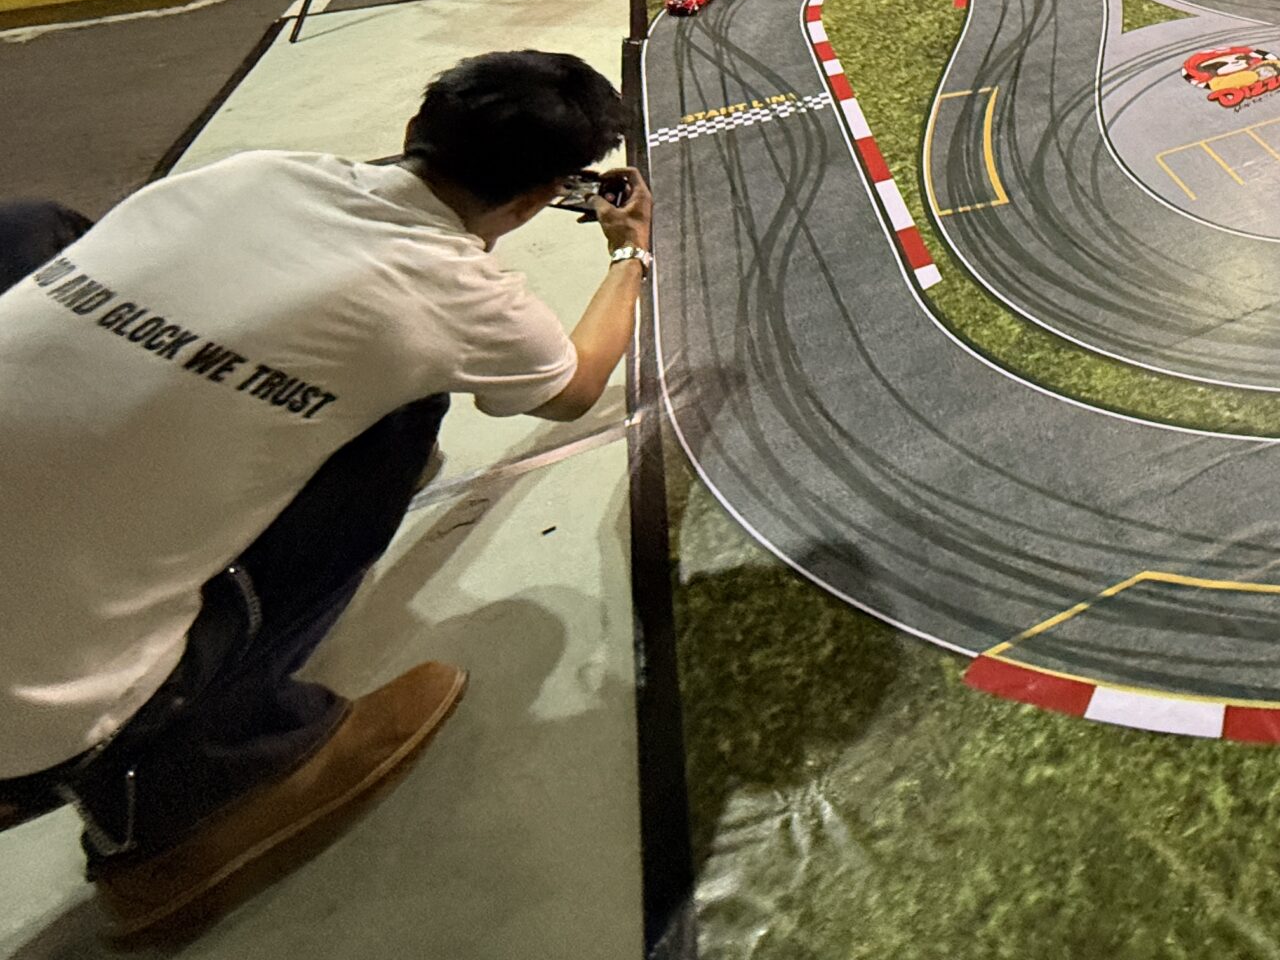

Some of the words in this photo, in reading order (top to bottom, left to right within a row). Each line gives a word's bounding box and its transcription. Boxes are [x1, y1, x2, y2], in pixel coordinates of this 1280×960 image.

[47, 274, 117, 315] AND
[97, 302, 200, 360] GLOCK
[182, 342, 249, 383] WE
[235, 364, 337, 419] TRUST
